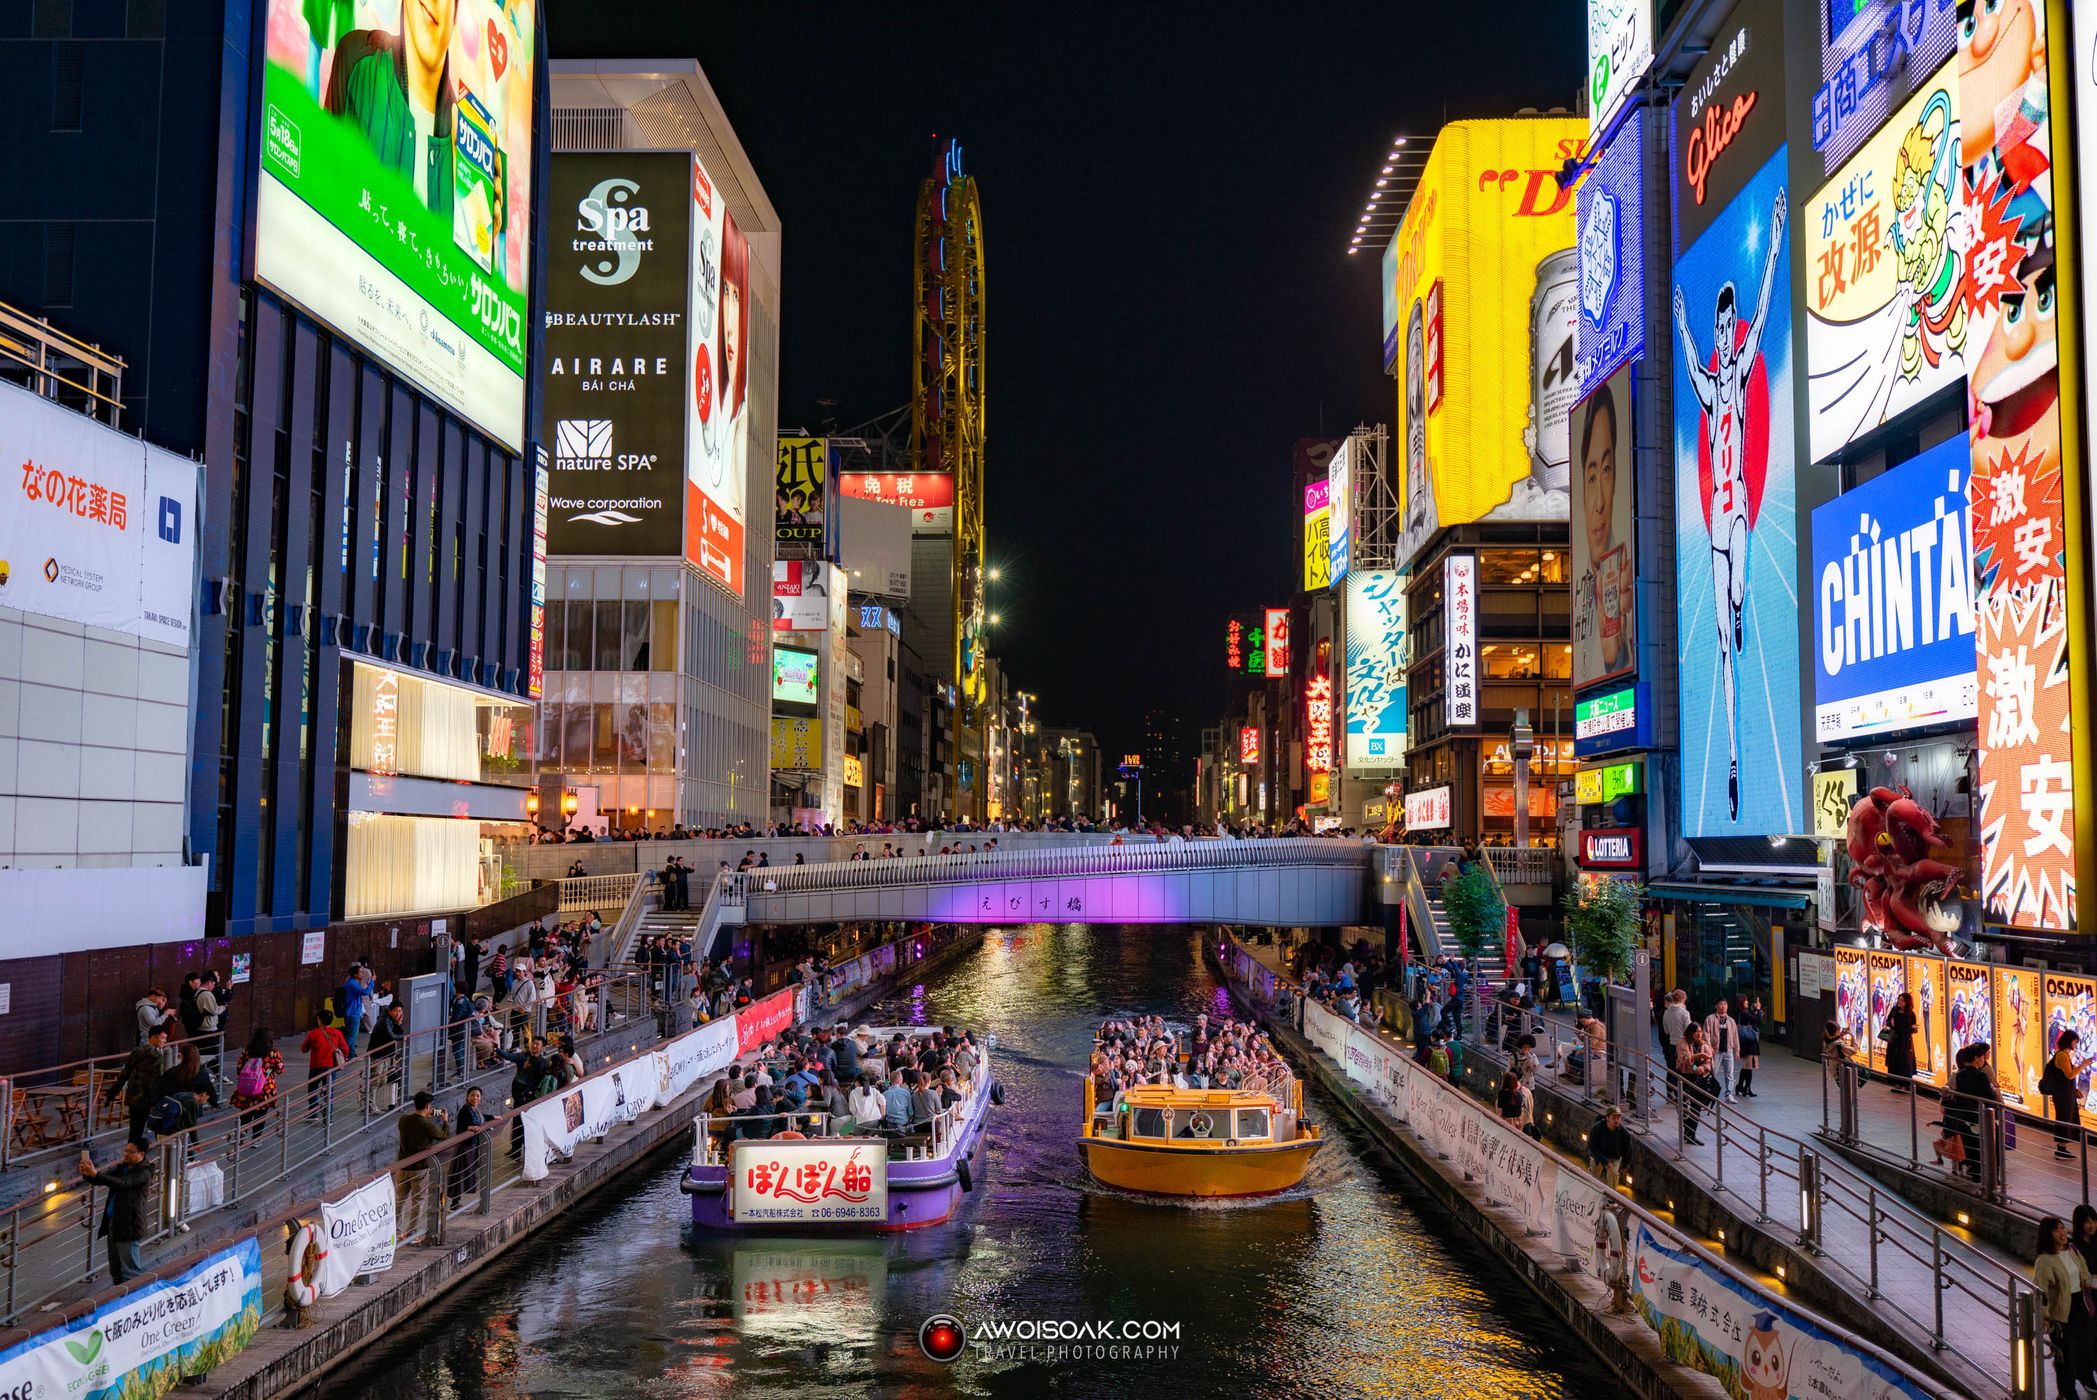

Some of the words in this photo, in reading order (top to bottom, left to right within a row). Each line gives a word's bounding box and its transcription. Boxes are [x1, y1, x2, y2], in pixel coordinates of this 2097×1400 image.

[1612, 8, 1637, 75] ピップ
[1691, 28, 1747, 118] おいしさと健康
[459, 116, 495, 178] サロンパス
[1687, 90, 1759, 206] Glico
[578, 198, 651, 240] Spa
[1821, 169, 1875, 241] かぜに
[573, 239, 653, 252] treatment
[699, 239, 716, 293] Spa
[1818, 200, 1881, 311] 改源
[471, 272, 522, 356] サロンパス
[551, 357, 667, 375] AIRARE
[582, 378, 606, 391] BÁI
[609, 378, 636, 391] CHÁ
[556, 456, 612, 471] nature
[1720, 404, 1743, 514] グリコ
[22, 459, 127, 531] なの花薬局
[550, 497, 584, 509] Wave
[586, 497, 662, 512] corporation
[864, 477, 914, 494] 免税
[899, 496, 925, 508] Free
[1988, 465, 2052, 577] 激安
[60, 564, 83, 578] MEDICAL
[84, 569, 104, 583] SYSTEM
[1307, 518, 1319, 587] バイト
[60, 575, 84, 588] NETWORK
[85, 579, 103, 592] GROUP
[1455, 582, 1470, 637] 本場の味
[1228, 619, 1241, 669] お好み焼
[1454, 642, 1473, 719] かに道楽
[1370, 742, 1384, 752] BX
[1985, 643, 2072, 860] 激安
[1822, 780, 1849, 829] くくる
[1594, 836, 1629, 858] LOTTERIA
[982, 896, 1082, 912] えびす橋
[748, 1158, 872, 1203] ぽんぽん船
[742, 1207, 804, 1218] 一本松汽船株式会社
[821, 1207, 881, 1218] 06-6946-8363
[141, 1331, 160, 1348] One
[163, 1317, 196, 1339] Green
